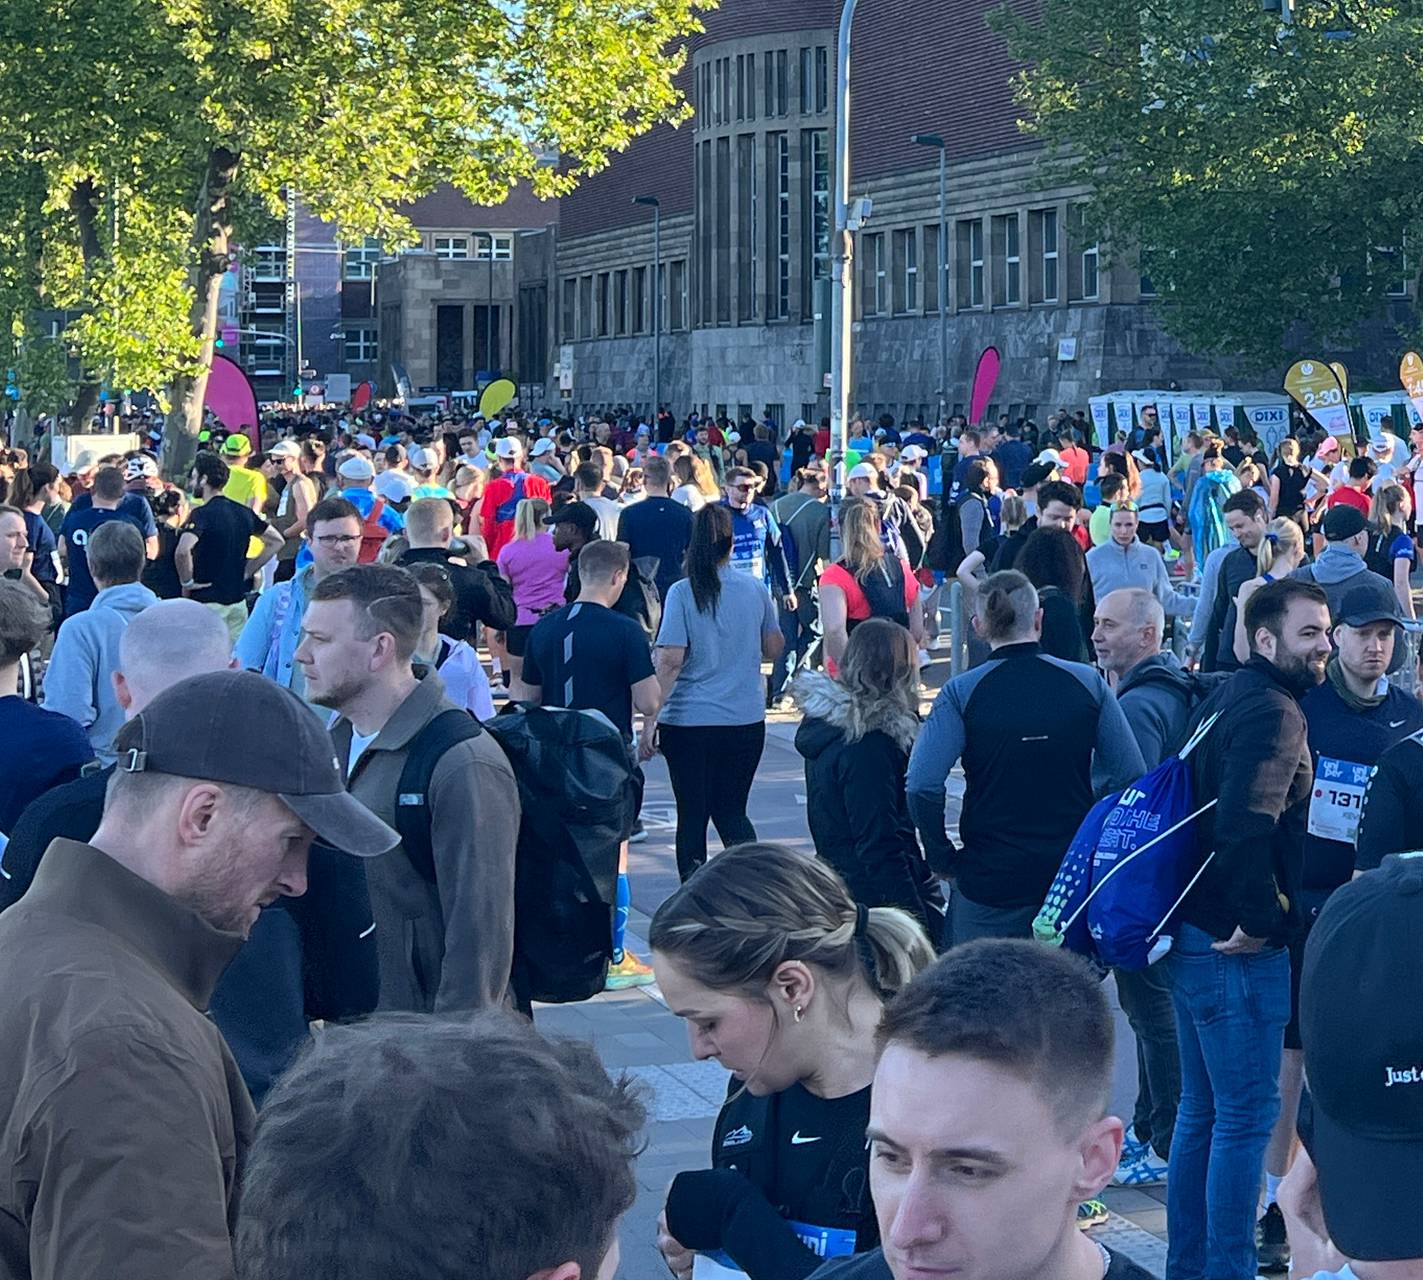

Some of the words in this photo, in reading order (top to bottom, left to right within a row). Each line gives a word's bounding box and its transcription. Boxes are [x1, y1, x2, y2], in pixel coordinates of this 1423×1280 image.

[1304, 388, 1342, 409] 2:30
[1255, 409, 1284, 422] DIXI
[1385, 1066, 1420, 1087] Just
